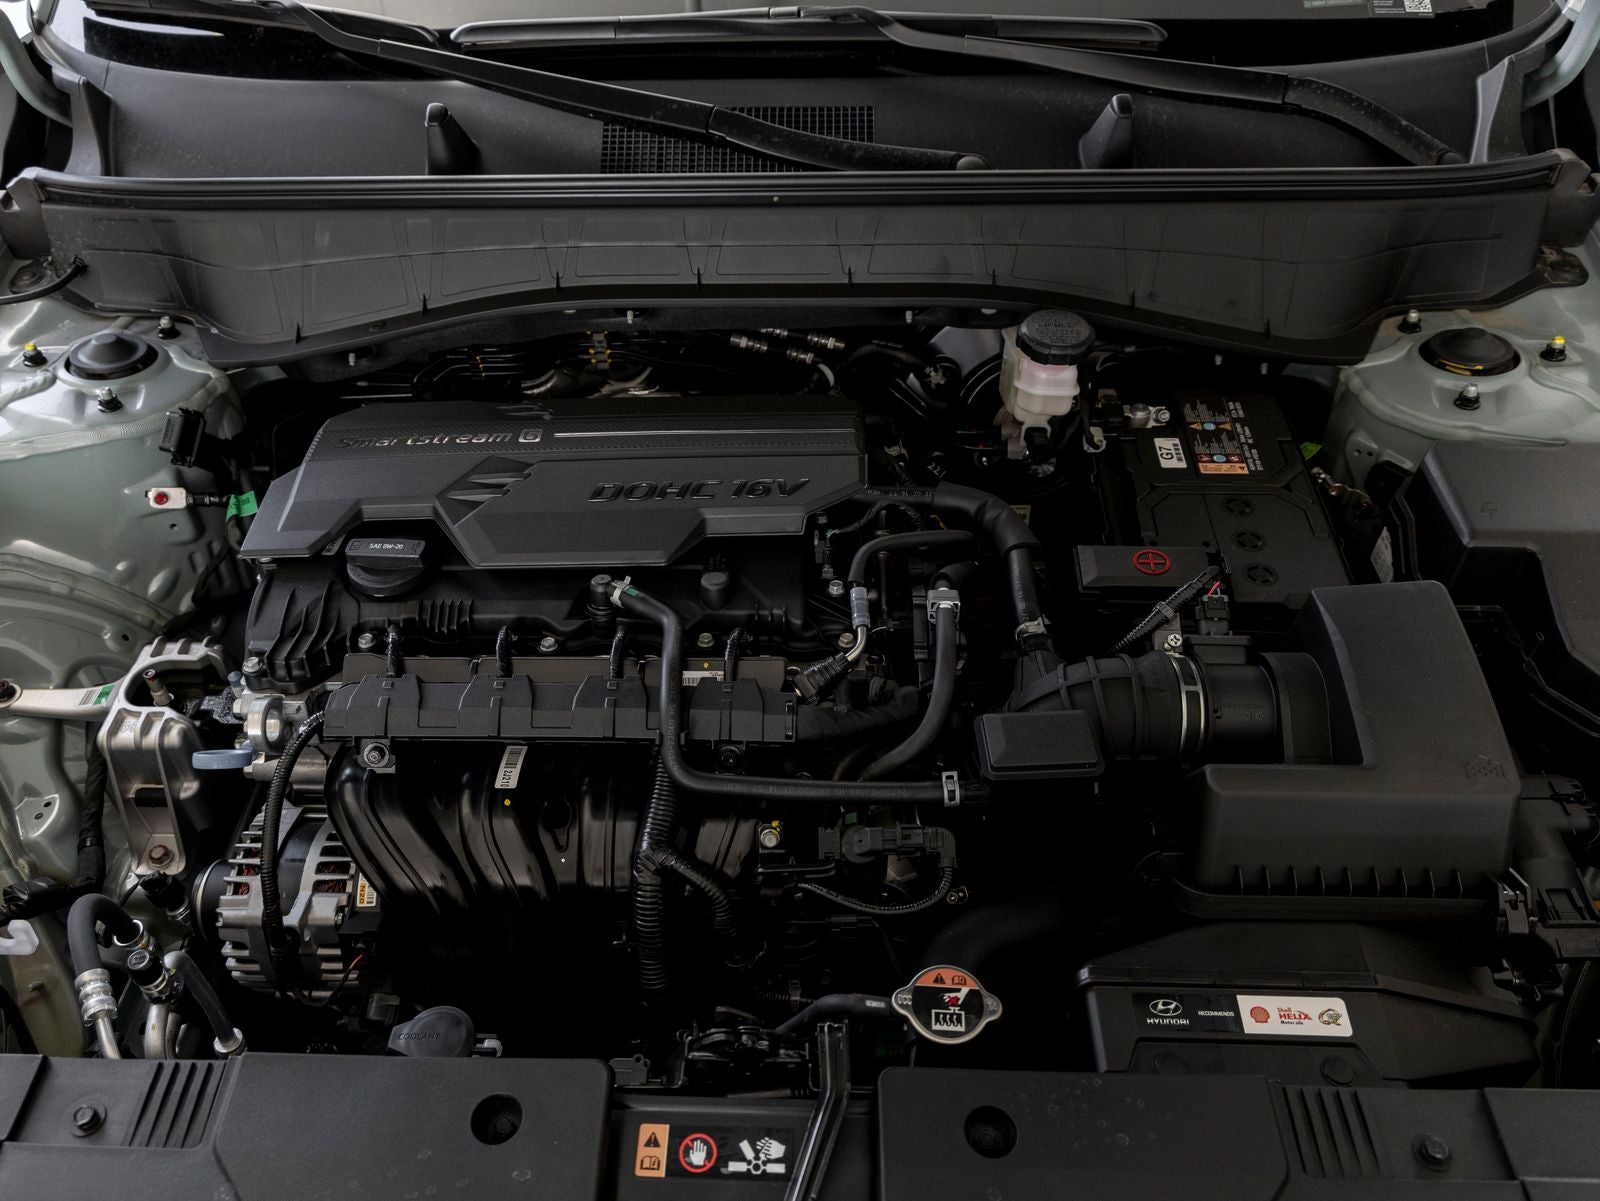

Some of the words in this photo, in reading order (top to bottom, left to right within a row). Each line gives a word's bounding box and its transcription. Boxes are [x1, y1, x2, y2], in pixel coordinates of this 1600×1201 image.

[333, 430, 513, 449] Smartstream
[1158, 445, 1174, 461] G7
[587, 479, 723, 502] DOHC
[731, 478, 810, 499] 16V
[1146, 1017, 1190, 1026] HYUNDAI
[1279, 1010, 1313, 1021] HELIX
[398, 1031, 441, 1041] COOLANT
